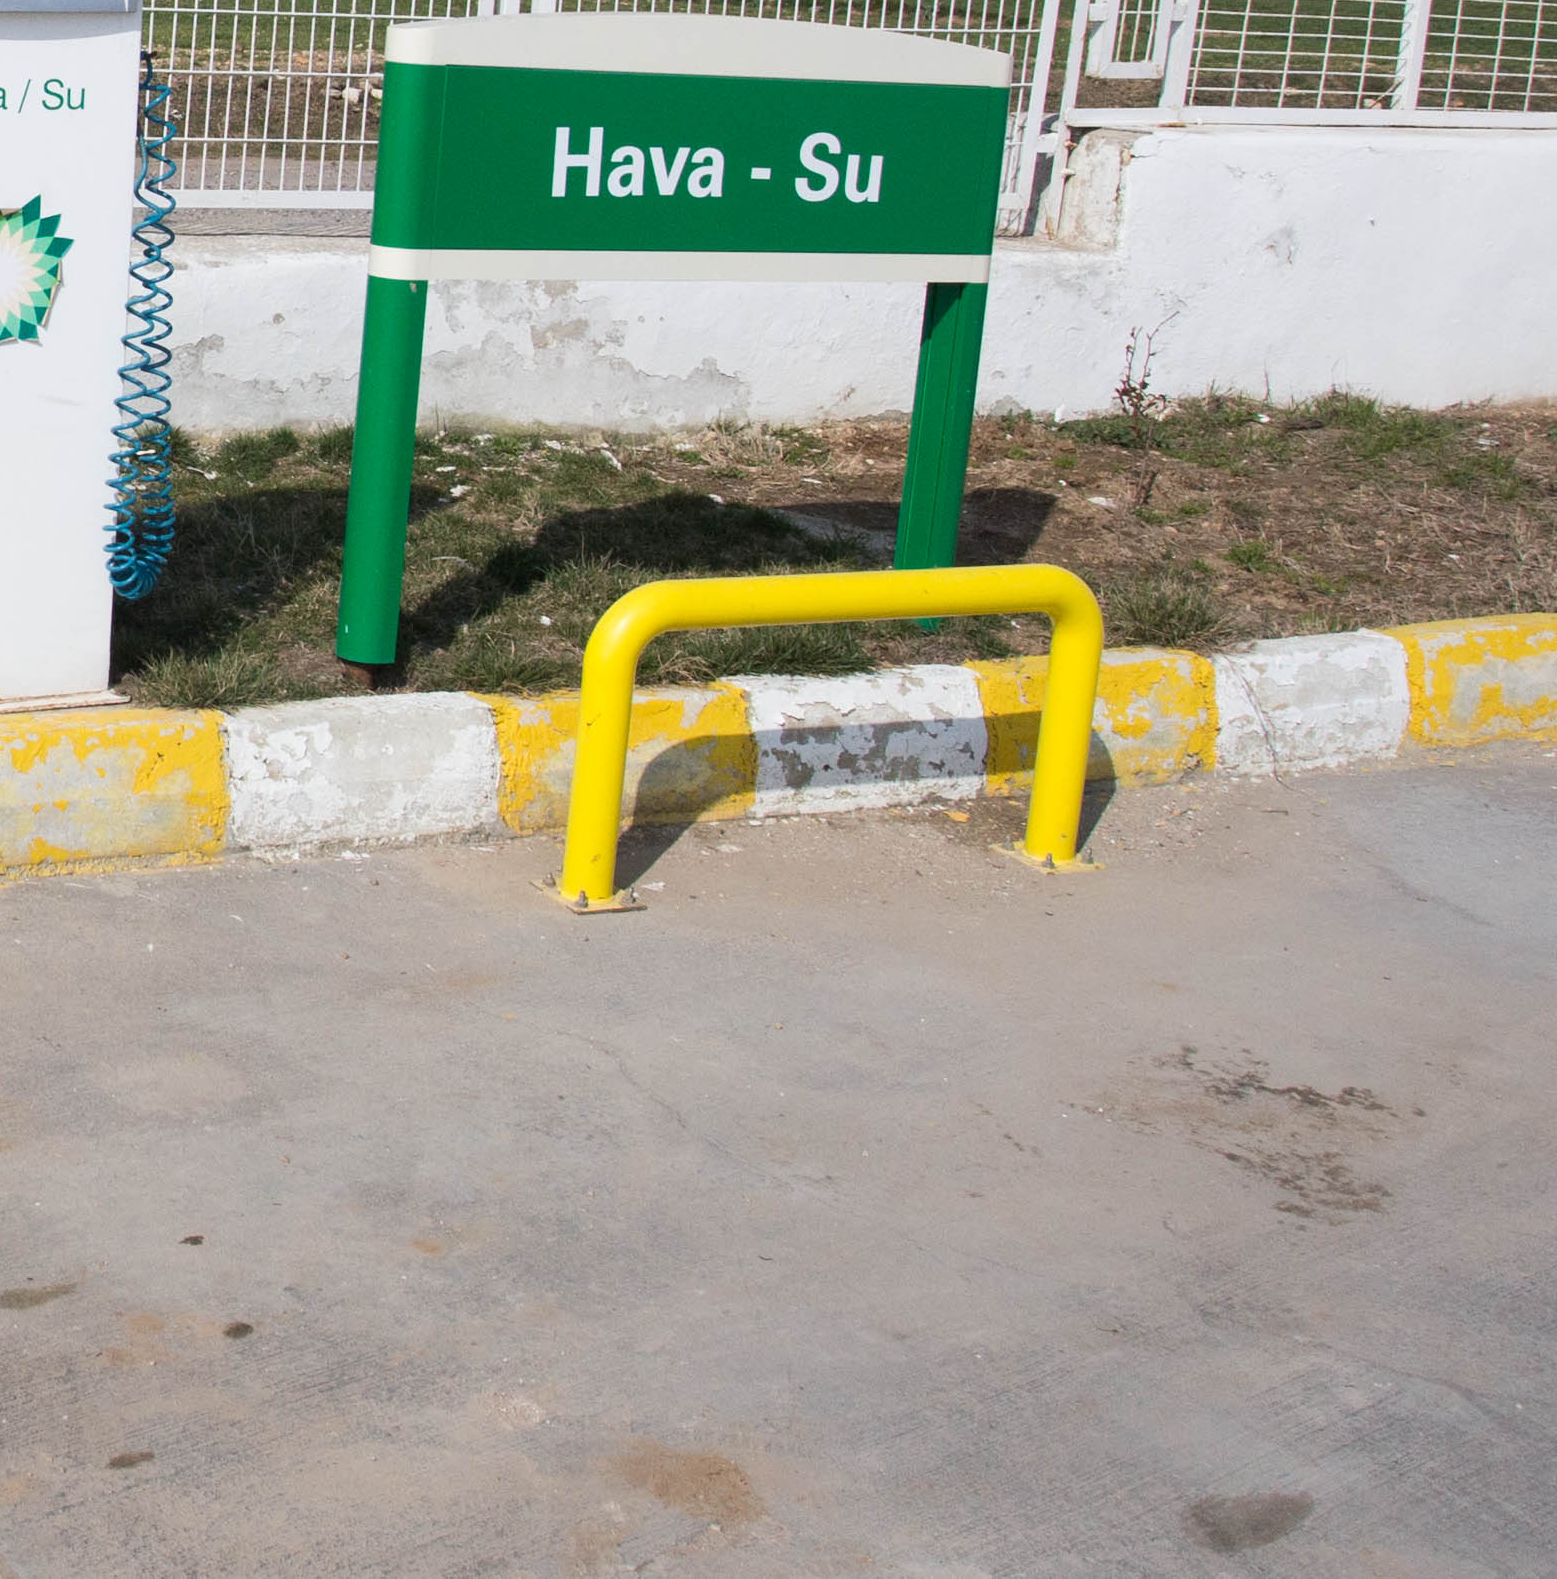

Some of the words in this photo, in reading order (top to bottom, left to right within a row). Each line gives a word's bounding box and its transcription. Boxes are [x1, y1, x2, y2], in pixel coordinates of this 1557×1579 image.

[18, 79, 32, 114] /
[41, 78, 86, 111] Su
[551, 126, 725, 198] Hava
[750, 167, 772, 180] -
[795, 131, 884, 203] Su
